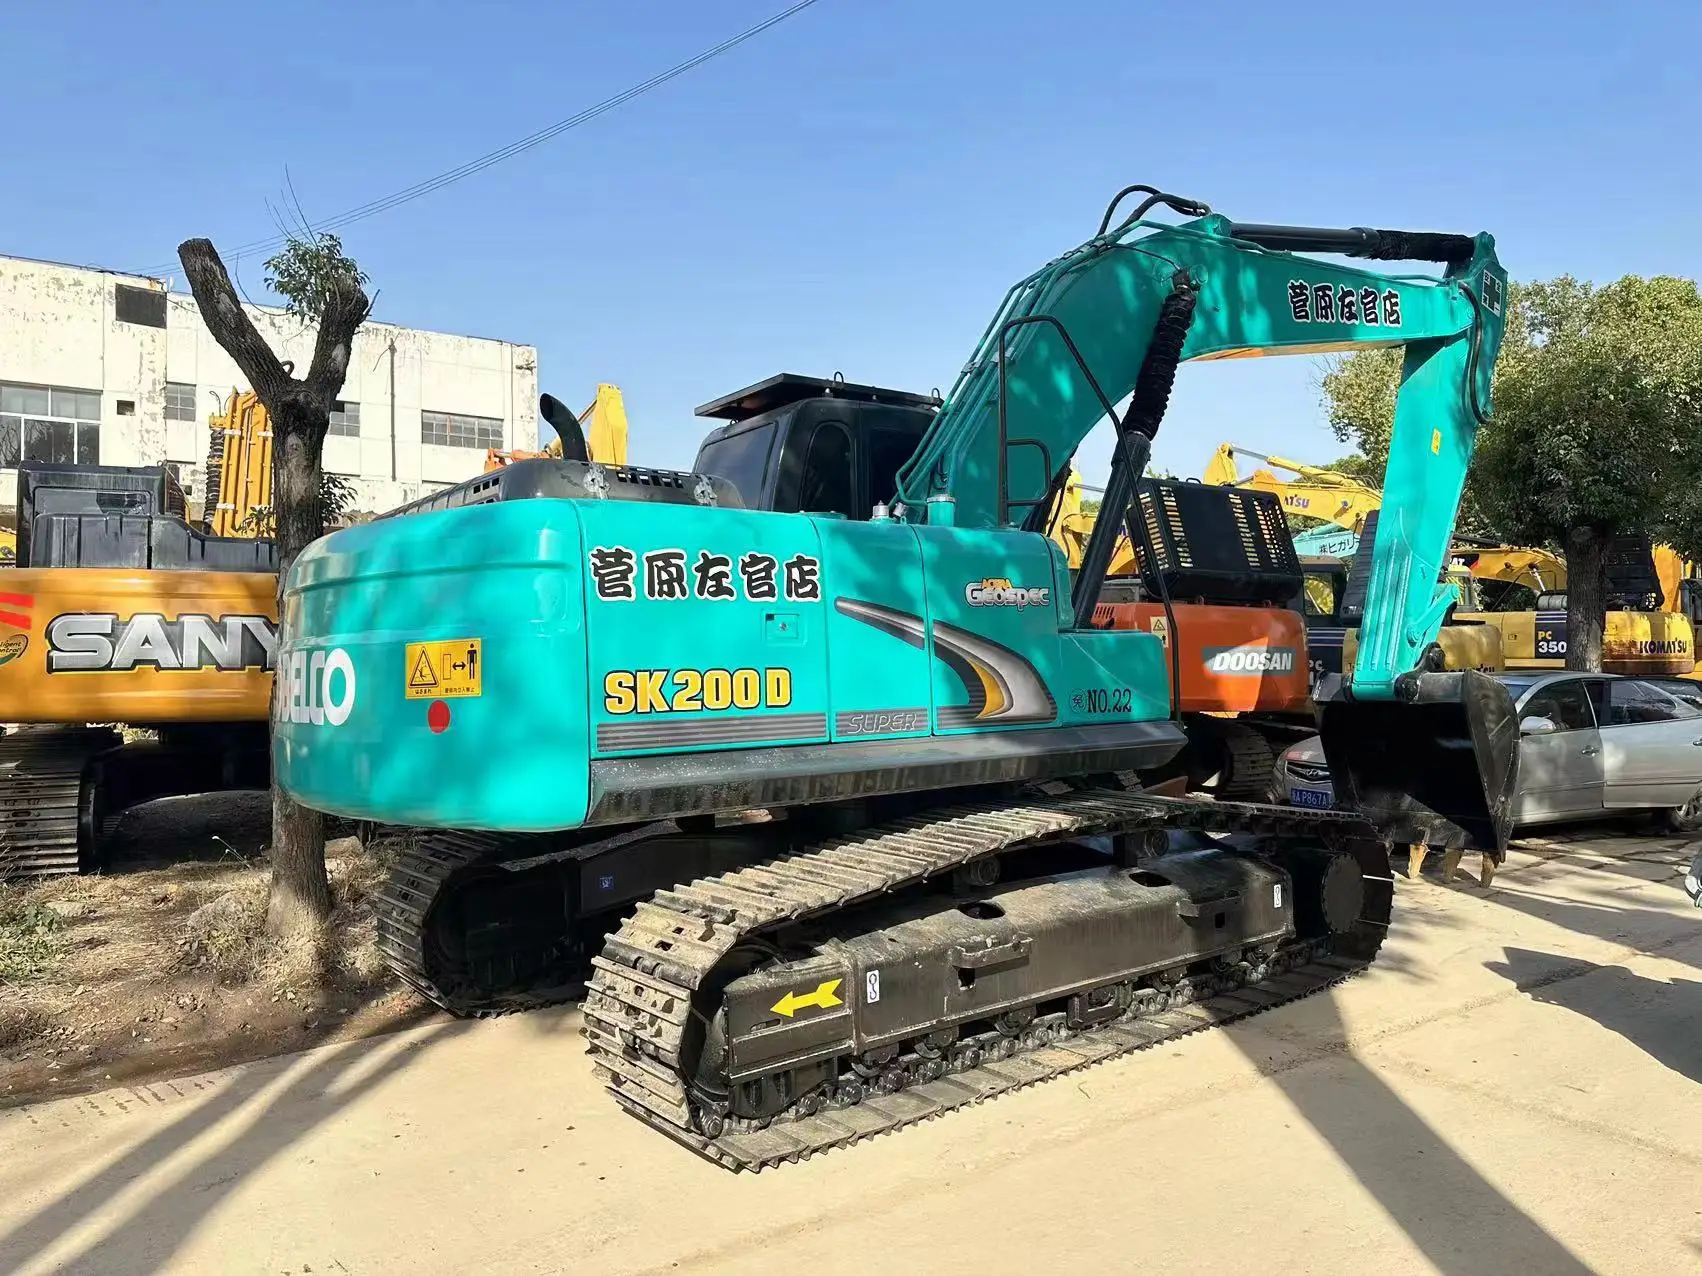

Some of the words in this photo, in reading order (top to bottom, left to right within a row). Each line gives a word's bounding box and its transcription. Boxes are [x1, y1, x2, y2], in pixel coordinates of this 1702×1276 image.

[1537, 631, 1552, 640] PC
[1538, 641, 1567, 653] 350
[1213, 652, 1292, 671] DOOSAN
[1087, 688, 1132, 713] NO.22
[847, 712, 917, 734] SUPER
